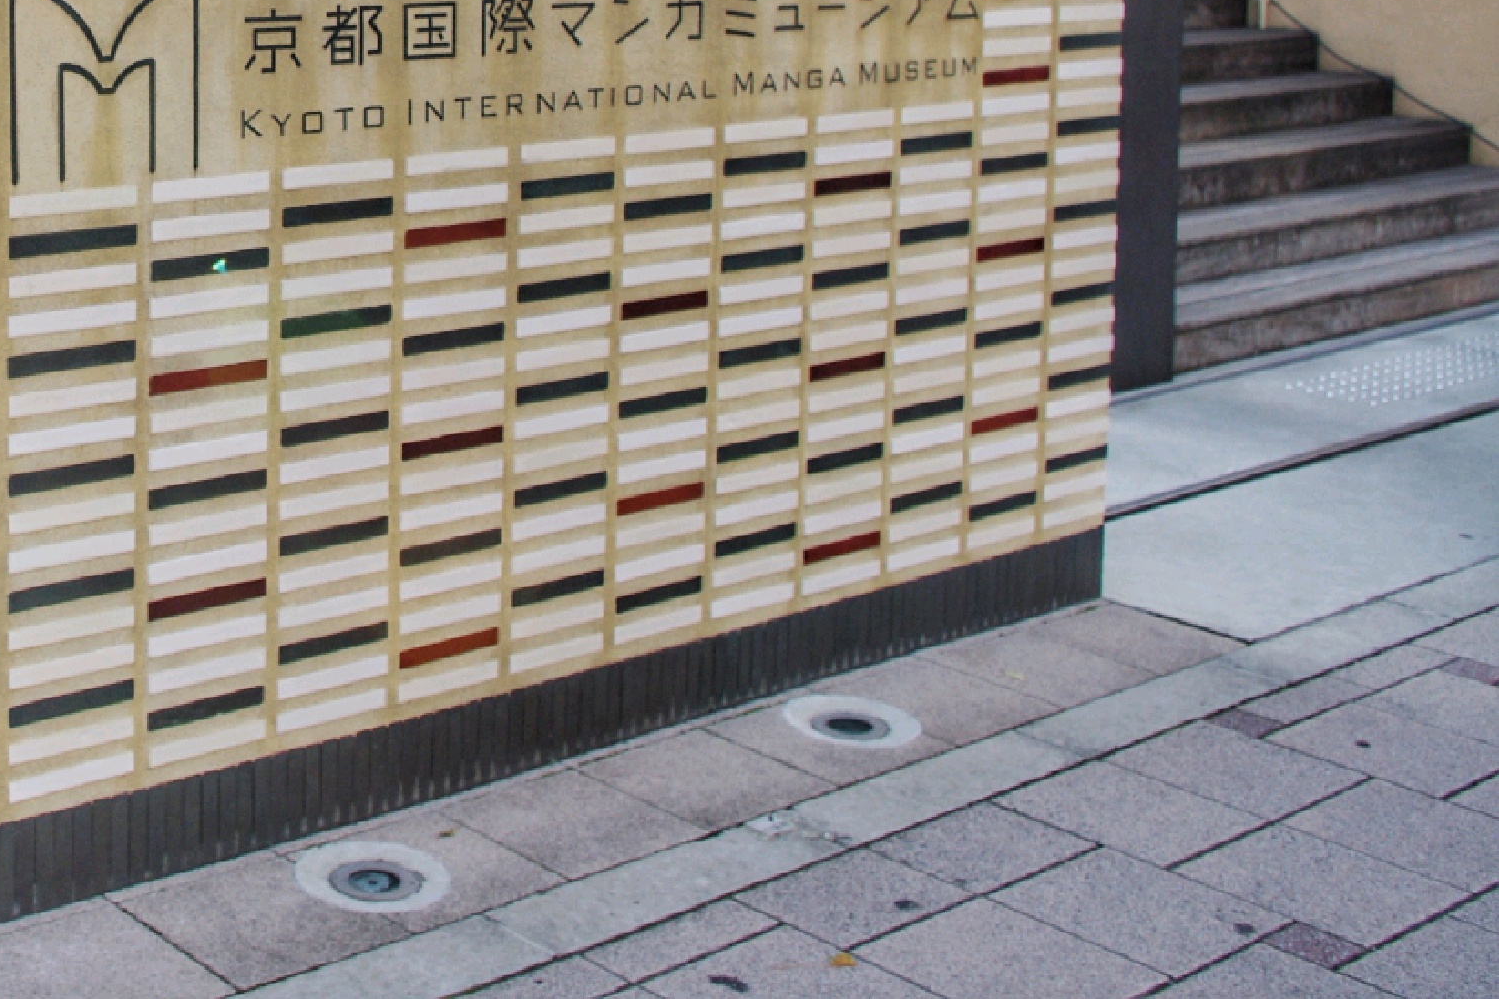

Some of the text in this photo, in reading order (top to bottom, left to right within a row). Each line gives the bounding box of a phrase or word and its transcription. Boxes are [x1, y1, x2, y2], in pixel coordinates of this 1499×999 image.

[239, 57, 980, 139] KYOTO INTERNATIONAL MANGA MUSEUM
